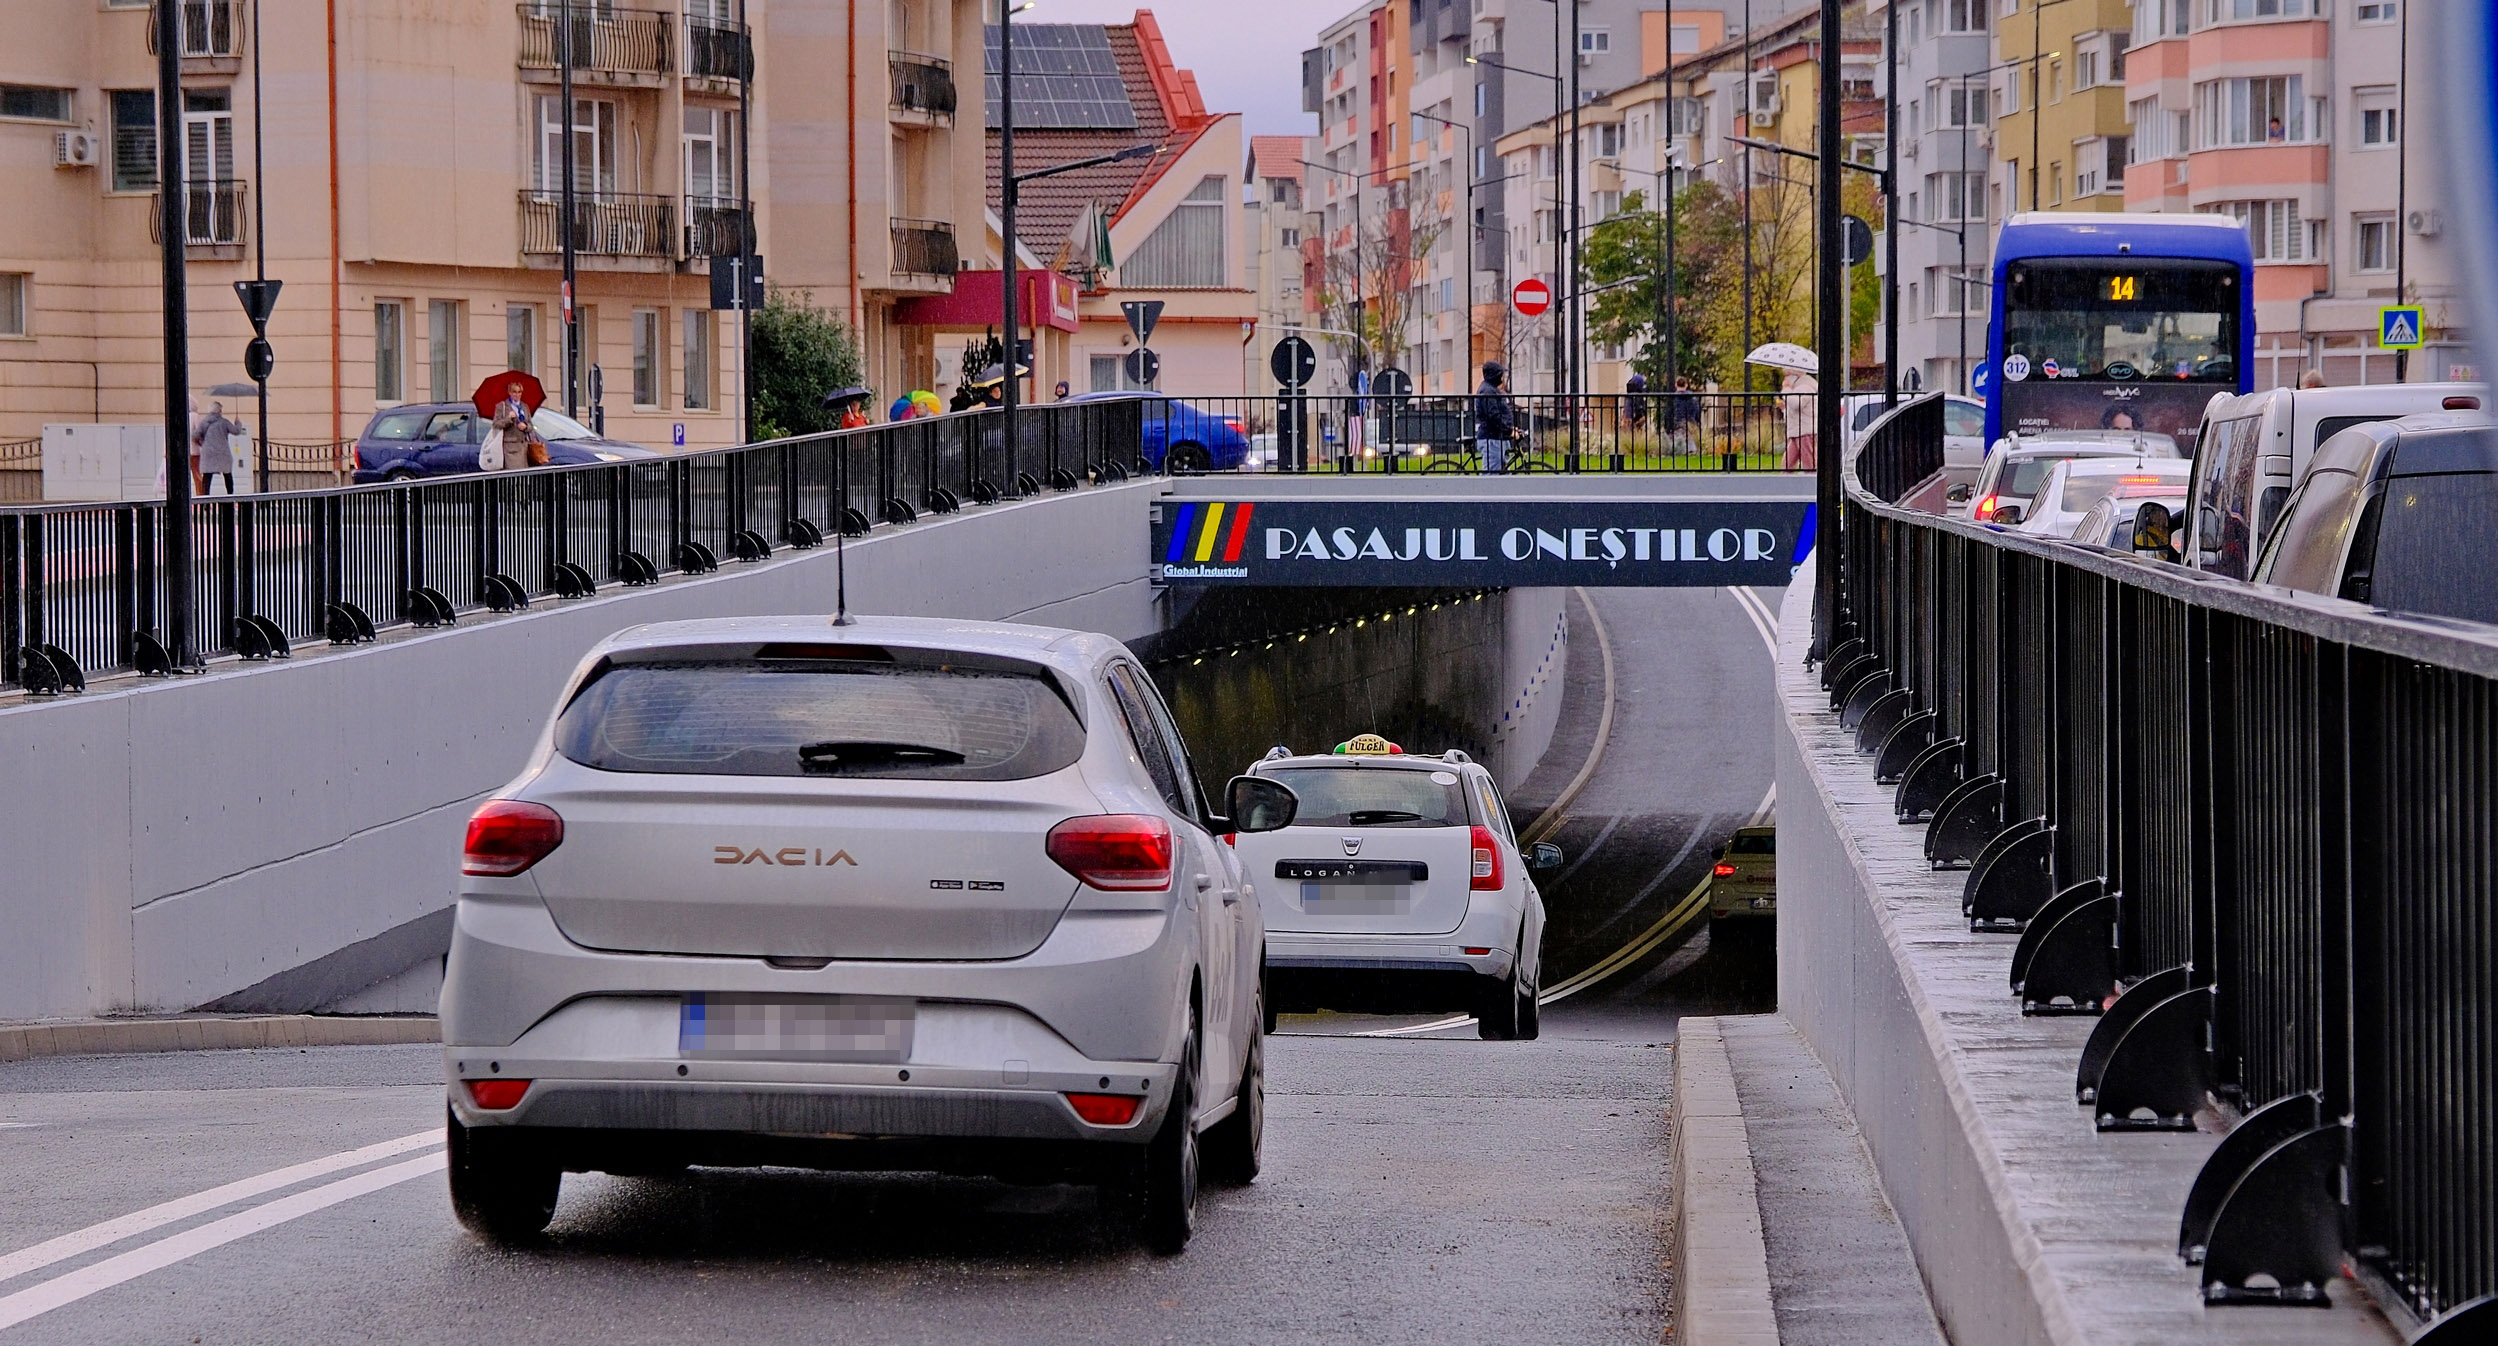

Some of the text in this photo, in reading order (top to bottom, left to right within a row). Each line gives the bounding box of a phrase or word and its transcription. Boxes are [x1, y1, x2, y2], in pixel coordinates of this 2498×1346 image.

[2111, 276, 2134, 300] 14
[2006, 361, 2027, 374] 312
[2110, 367, 2131, 375] BYD
[675, 424, 683, 442] P
[1265, 526, 1777, 570] PASAJUL ONEȘTILOR
[1163, 564, 1248, 576] Global Industrial
[1350, 739, 1385, 751] FULGER
[714, 846, 859, 866] DACIA
